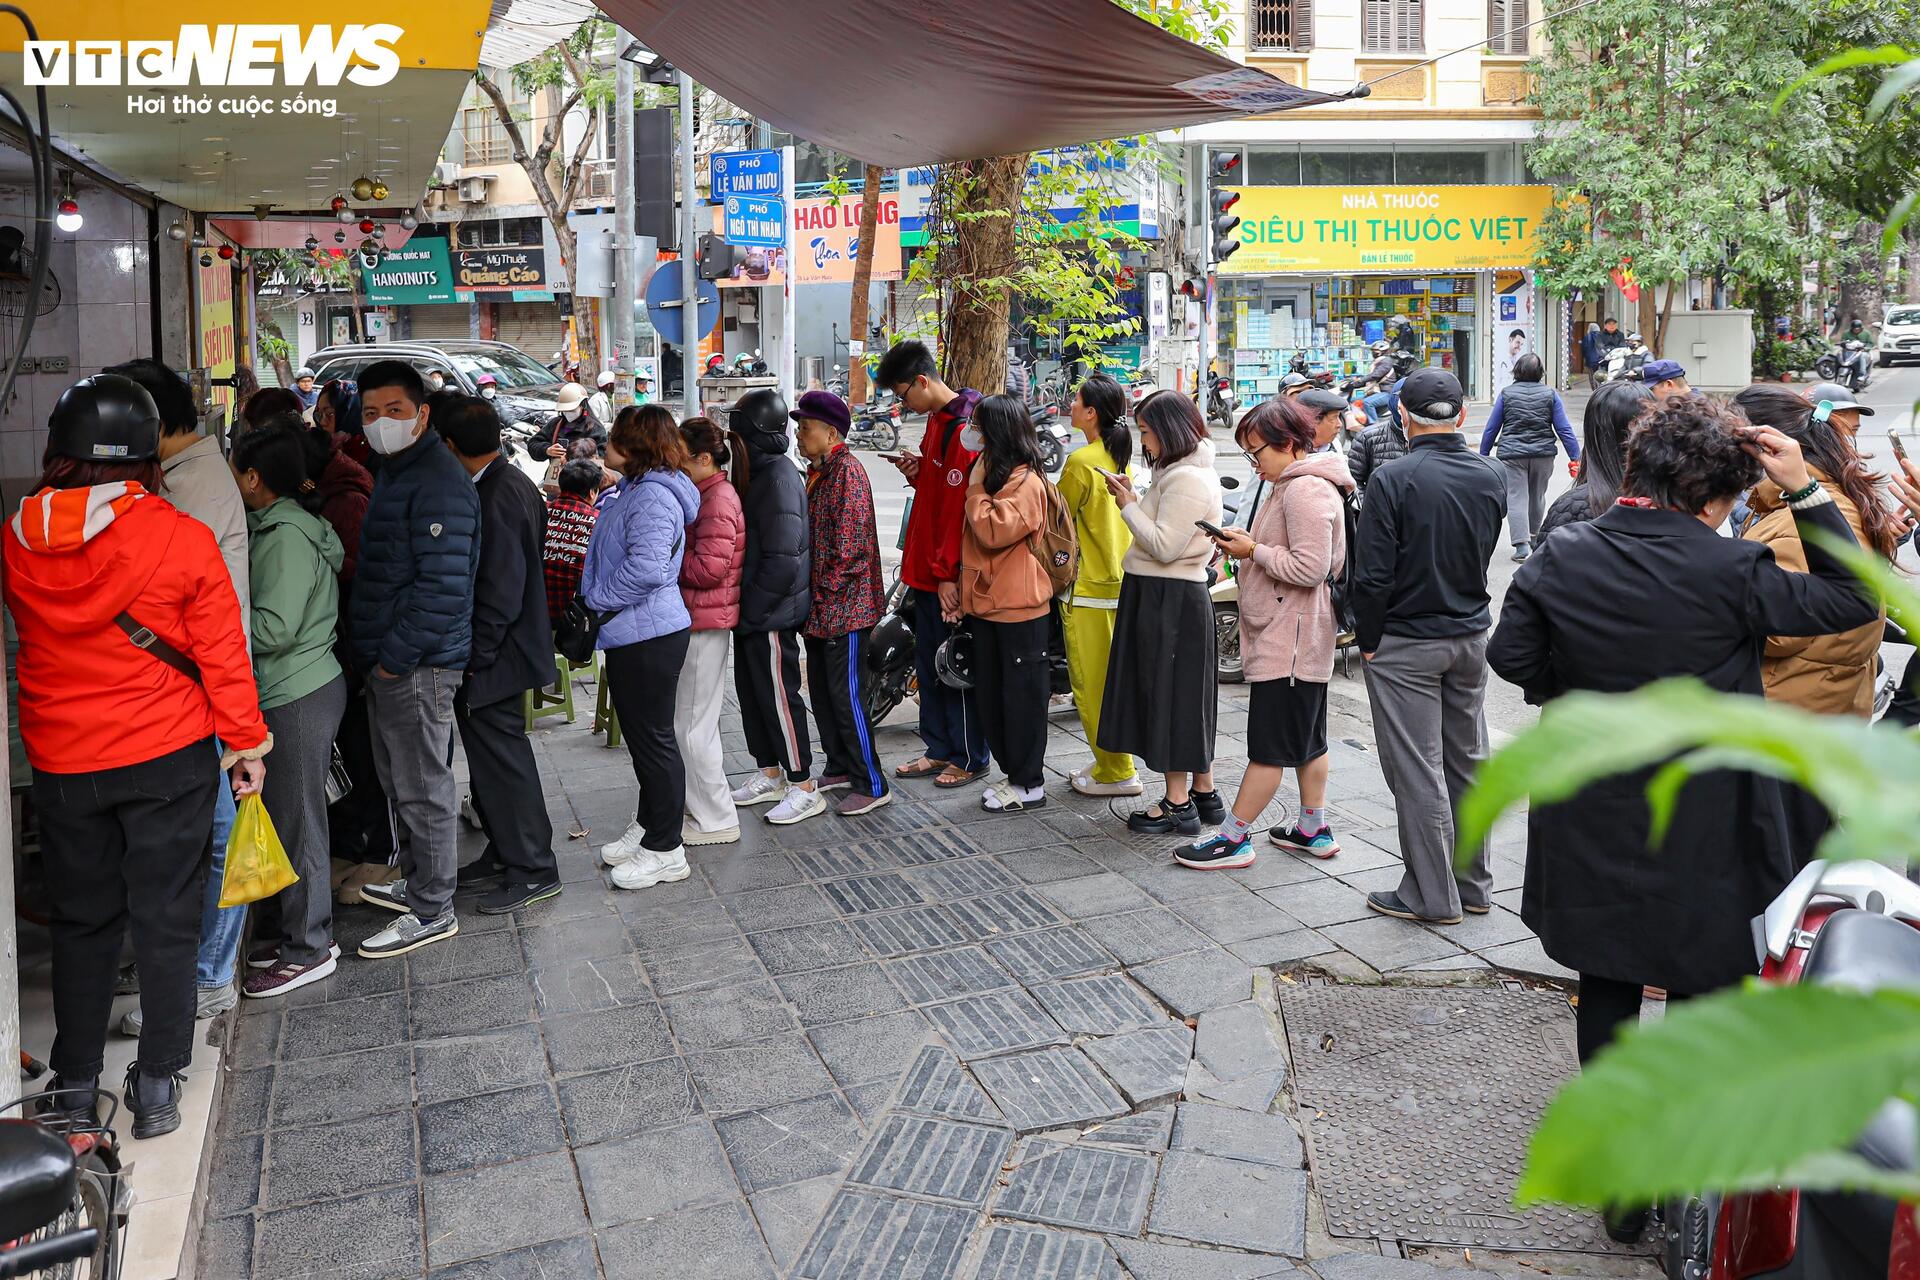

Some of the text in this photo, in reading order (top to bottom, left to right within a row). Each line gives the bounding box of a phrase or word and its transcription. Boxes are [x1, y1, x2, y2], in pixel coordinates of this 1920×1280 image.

[739, 154, 762, 169] PHỐ
[717, 171, 778, 192] LÊ VĂN HƯU
[749, 201, 769, 214] PHỐ
[1342, 191, 1440, 209] NHÀ THUỐC
[795, 203, 837, 231] HÁO
[730, 215, 745, 236] NGÔ
[760, 218, 781, 241] NHẬM
[1240, 213, 1528, 248] SIÊU THỊ THUỐC VIỆT
[372, 270, 438, 287] HANOINUTS
[460, 266, 541, 287] Quảng Cáo
[204, 321, 233, 369] SIÊU TO
